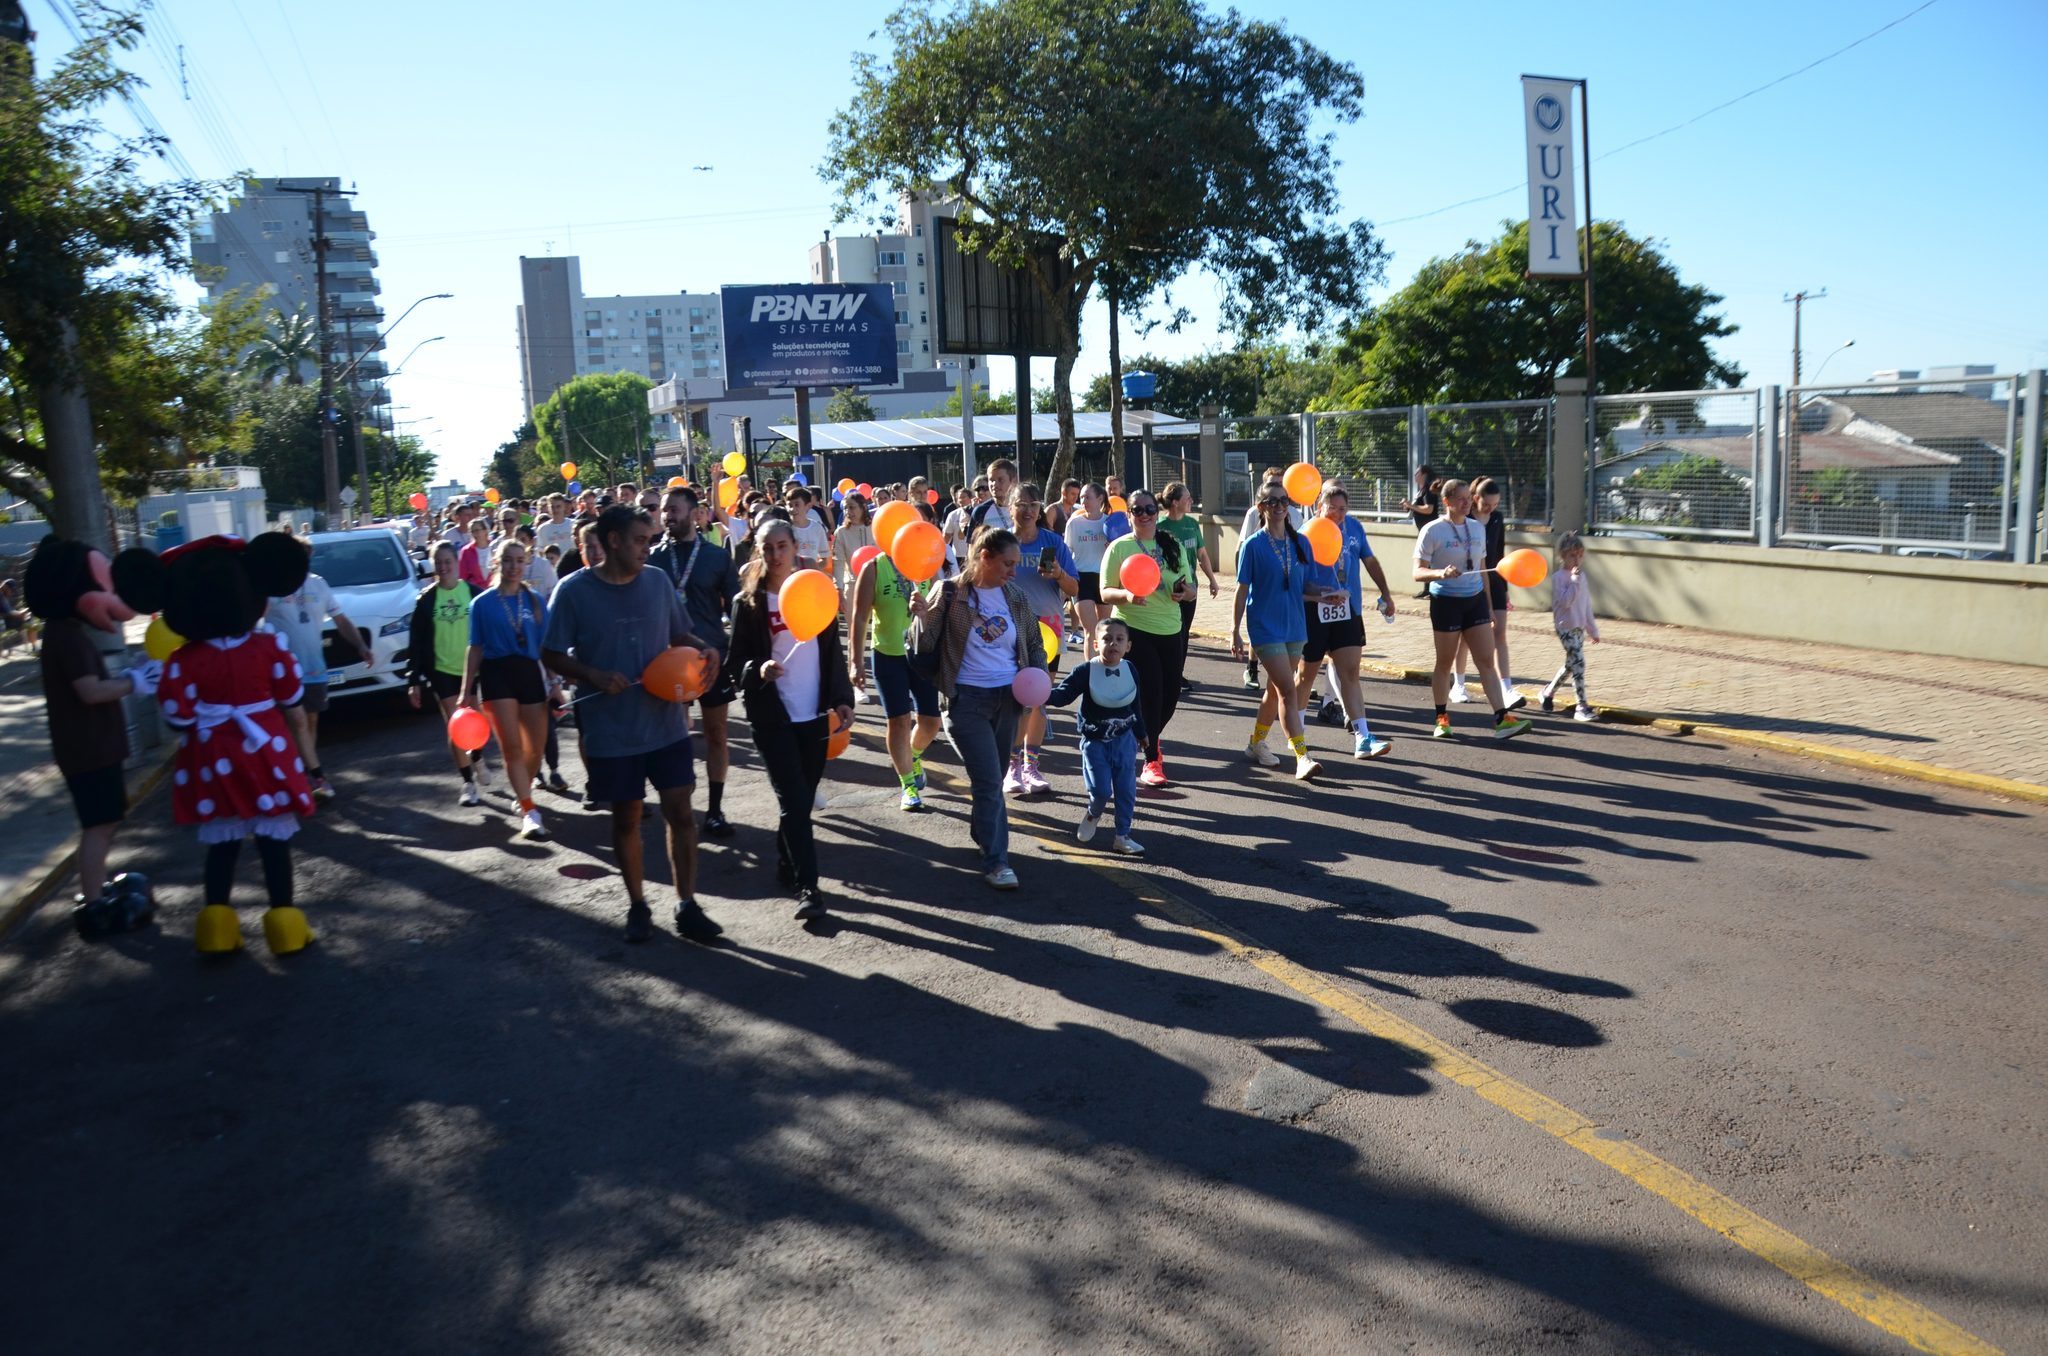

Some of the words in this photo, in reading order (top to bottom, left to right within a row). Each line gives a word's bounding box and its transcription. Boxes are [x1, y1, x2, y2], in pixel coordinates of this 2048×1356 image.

[1537, 143, 1566, 260] URI
[750, 293, 867, 322] PBNEW
[779, 322, 868, 334] SISTEMAS
[772, 342, 804, 351] Soluções
[805, 341, 850, 350] tecnológicas
[785, 350, 815, 358] produtos
[751, 369, 792, 378] pbnew.com.br
[846, 366, 882, 374] 3744-3880
[1322, 605, 1346, 620] 853
